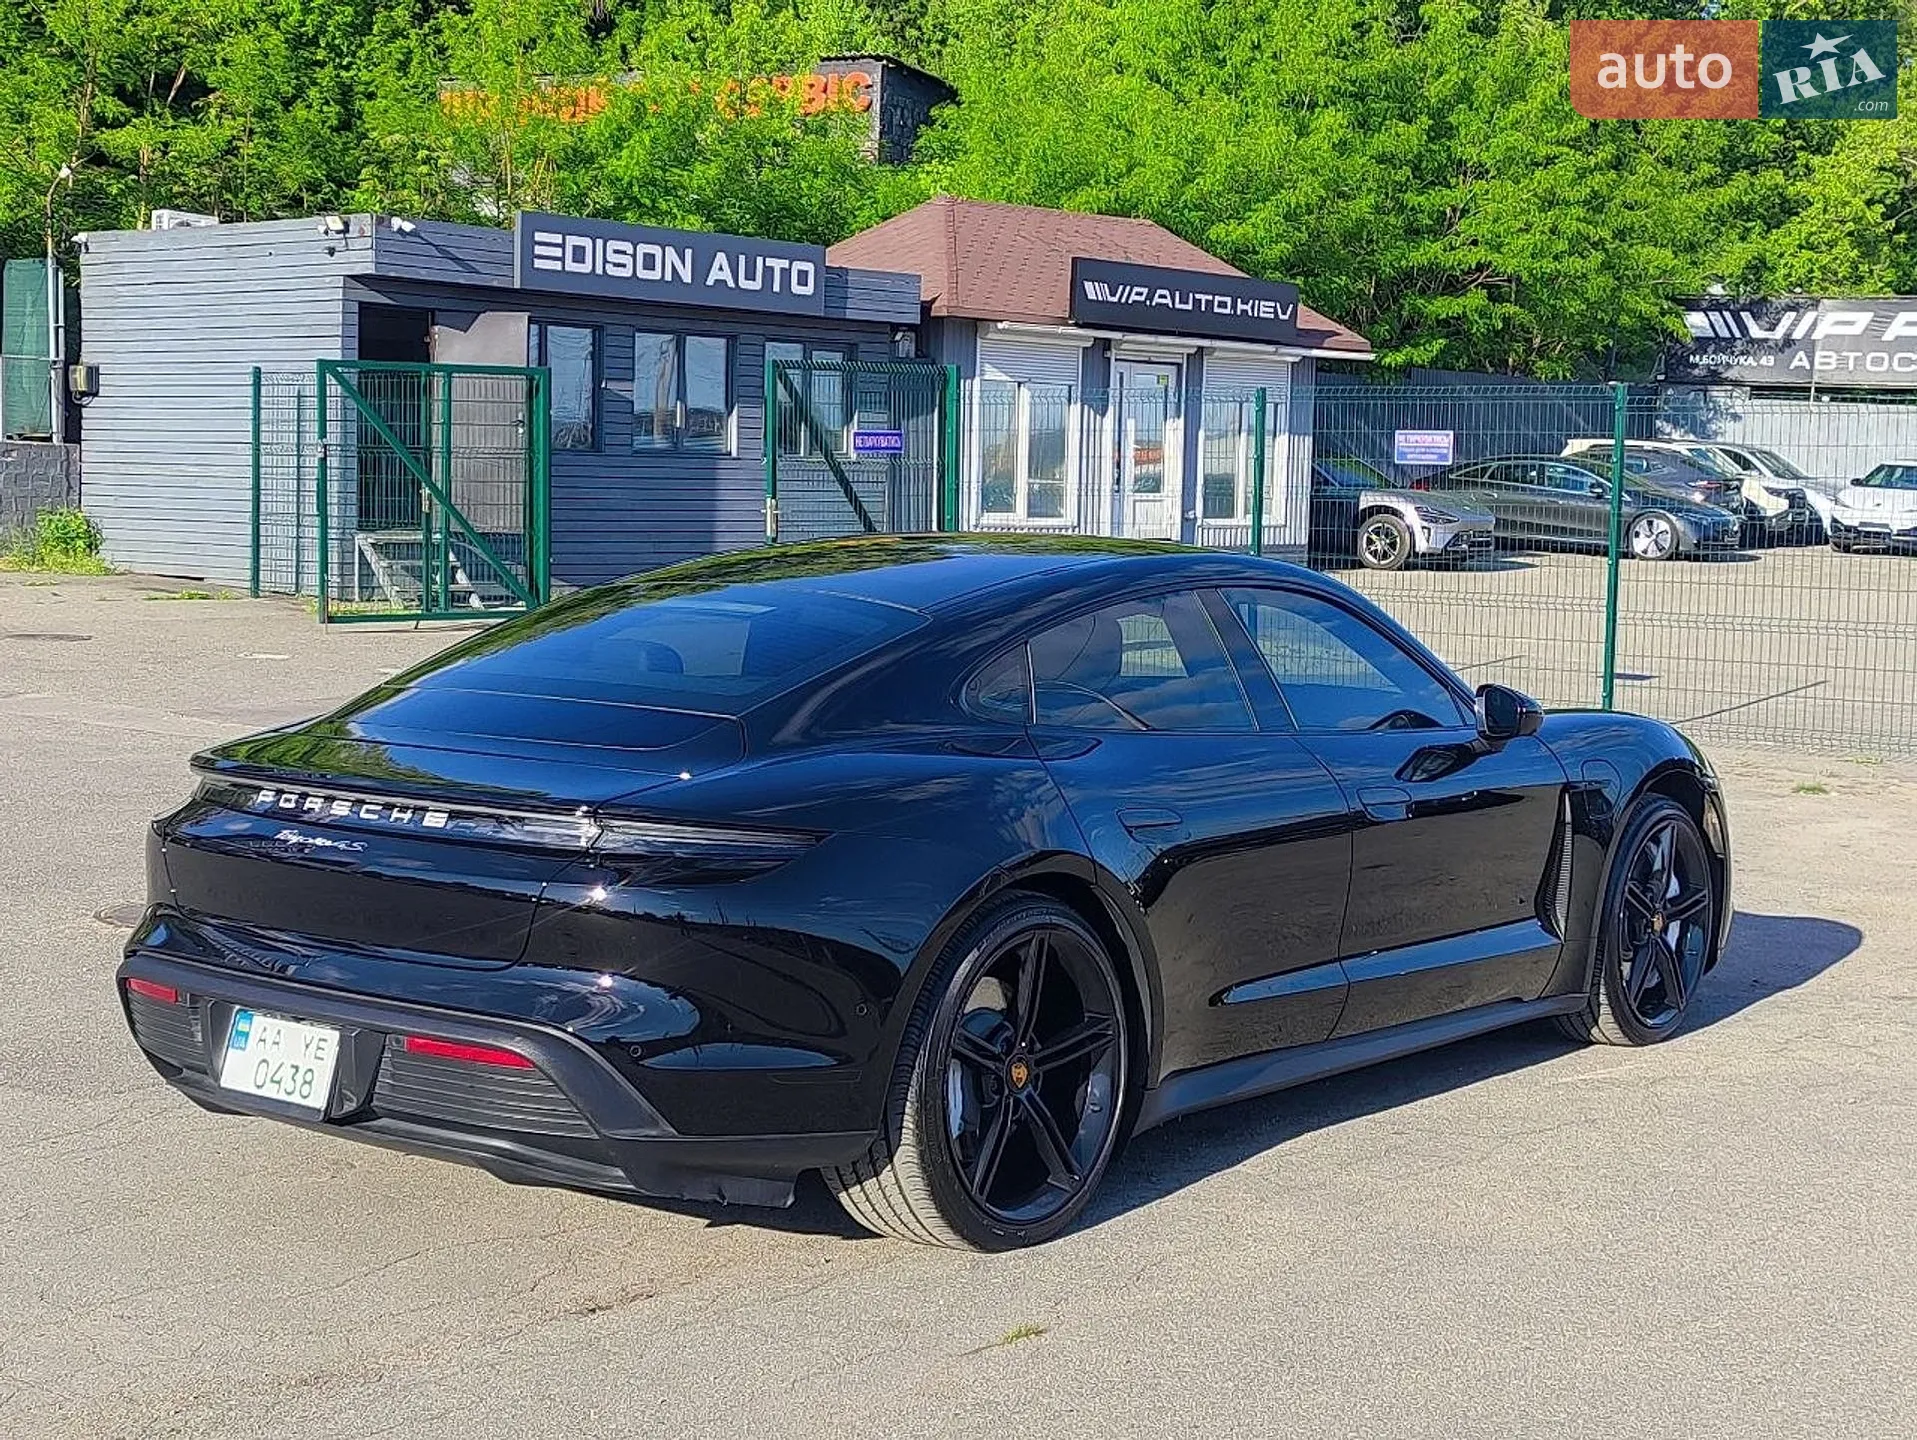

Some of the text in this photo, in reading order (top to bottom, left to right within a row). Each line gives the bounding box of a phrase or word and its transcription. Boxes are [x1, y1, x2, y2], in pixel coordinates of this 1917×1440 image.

[533, 231, 815, 296] EDISON AUTO
[1739, 311, 1875, 341] VIP
[255, 788, 449, 829] PORSCHE
[255, 1025, 329, 1062] AA YE
[253, 1058, 315, 1100] 0438
